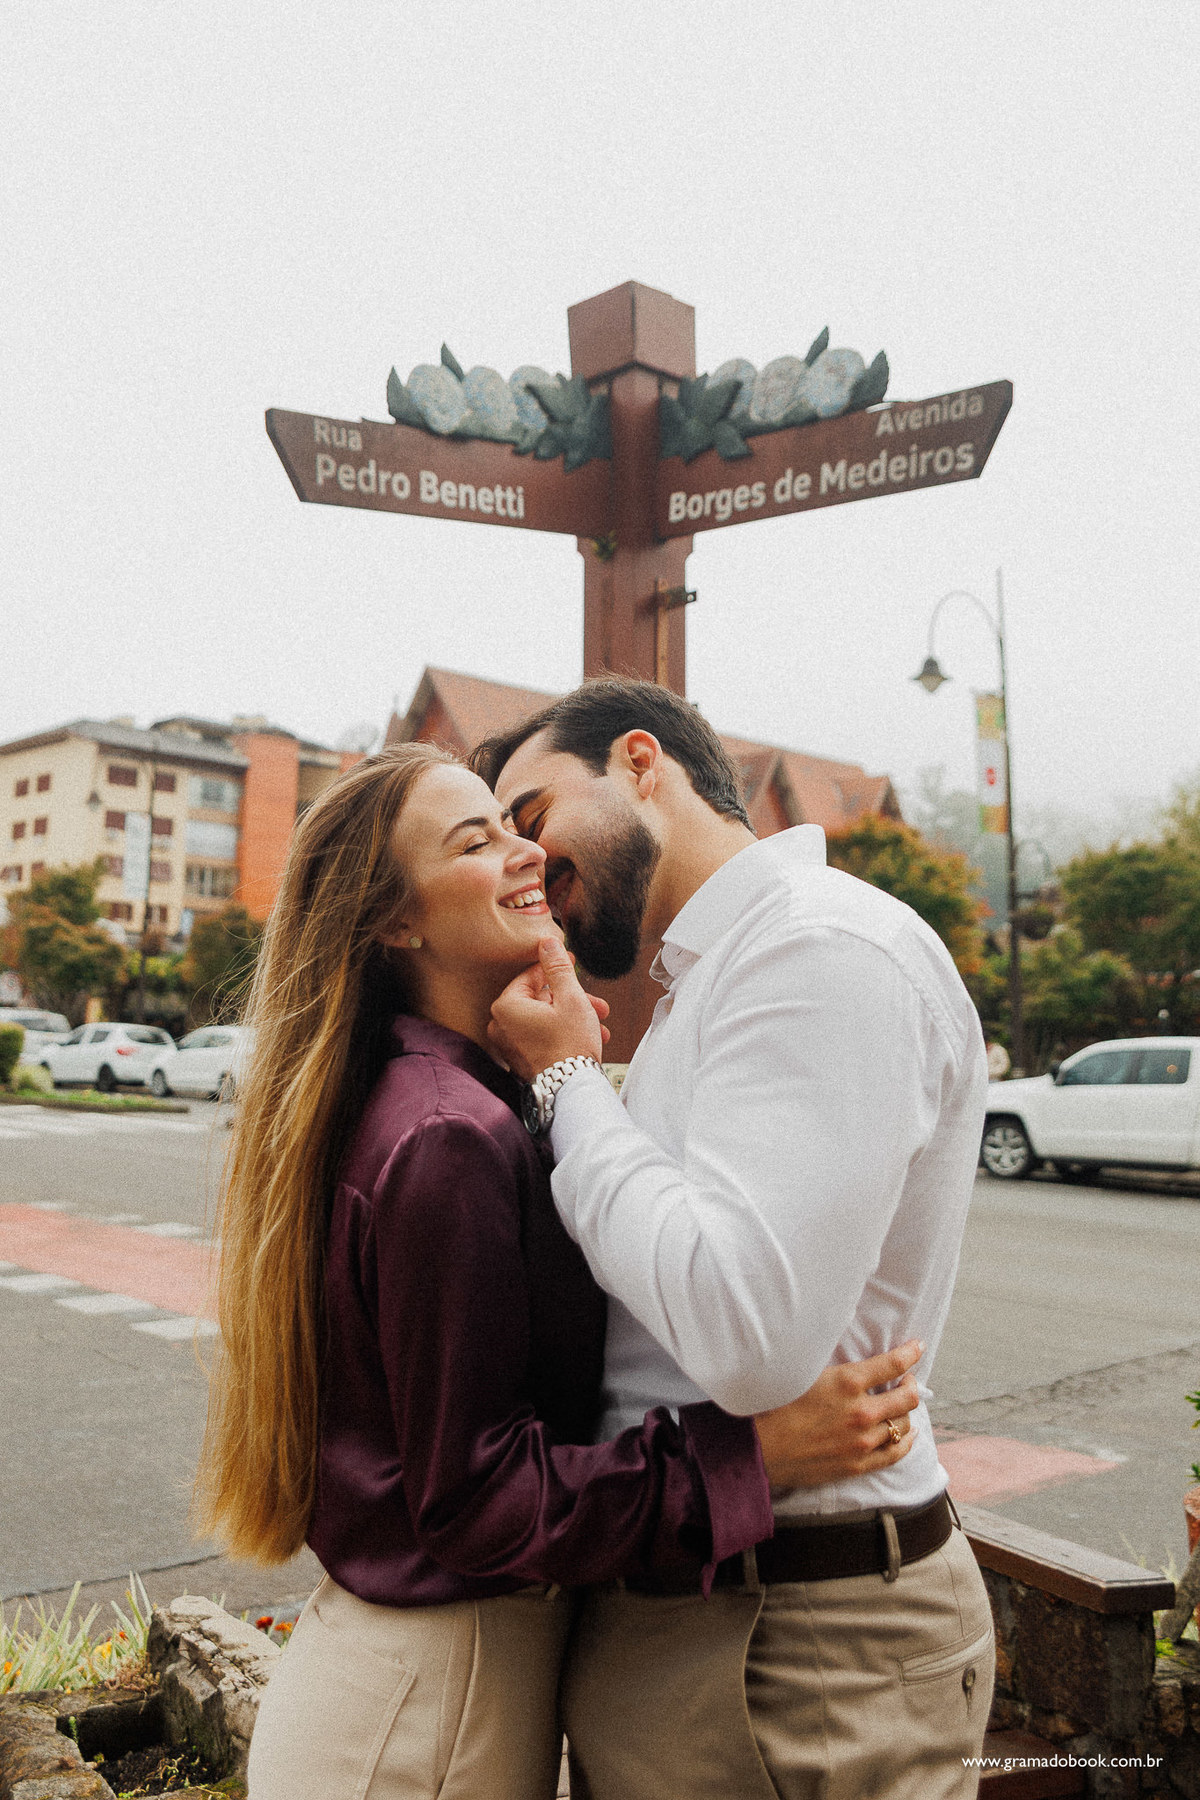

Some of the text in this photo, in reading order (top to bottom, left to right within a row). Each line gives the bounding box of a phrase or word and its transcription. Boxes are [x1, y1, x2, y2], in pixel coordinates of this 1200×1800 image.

[313, 418, 363, 452] Rua
[875, 391, 985, 437] Avenida
[315, 453, 525, 518] Pedro Benetti
[668, 442, 975, 522] Borges de Medeiros
